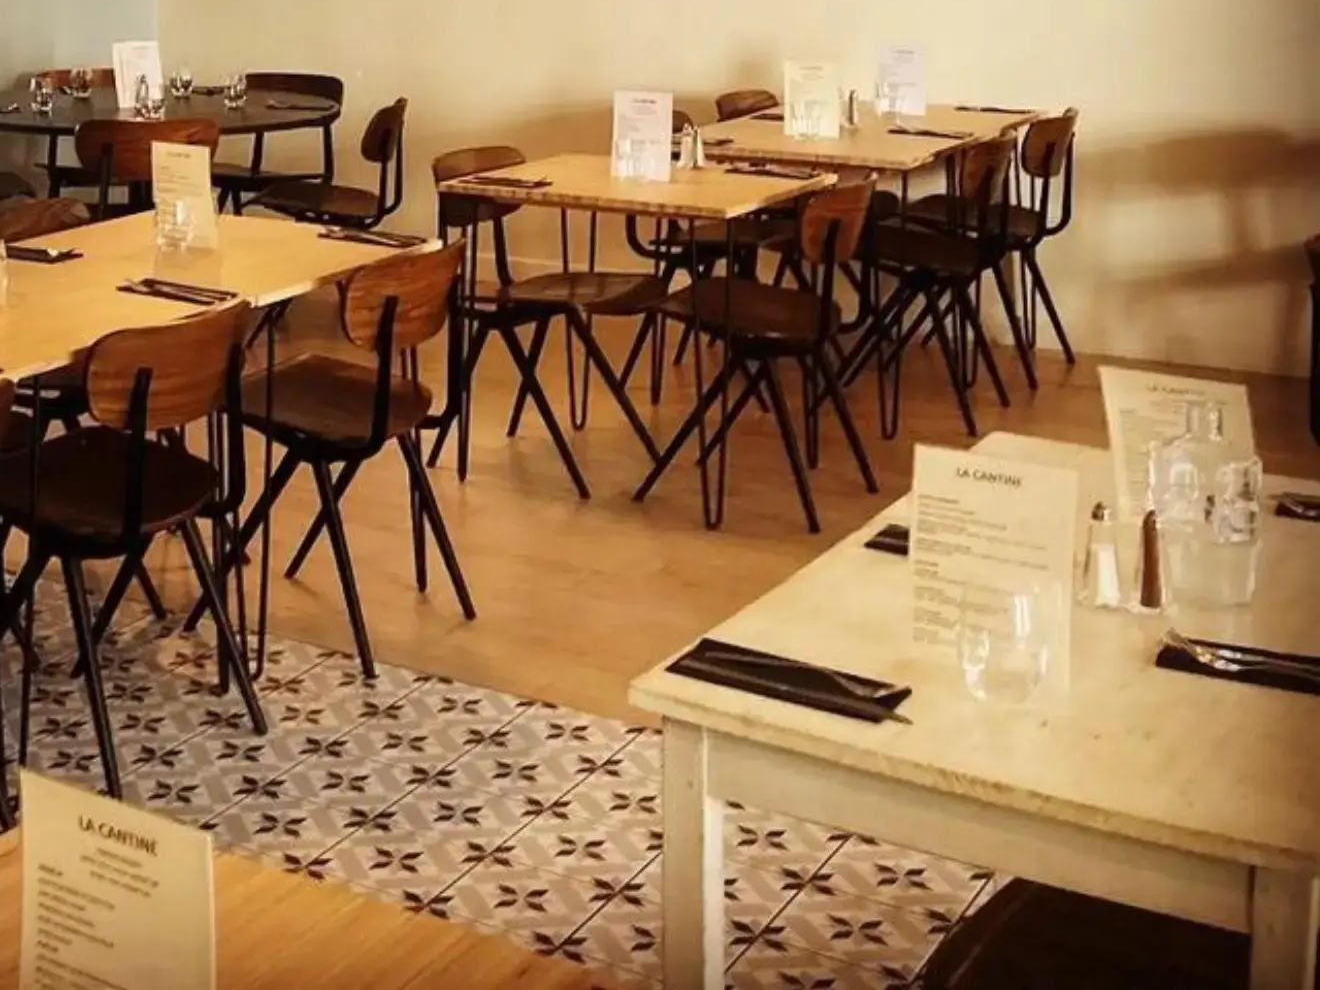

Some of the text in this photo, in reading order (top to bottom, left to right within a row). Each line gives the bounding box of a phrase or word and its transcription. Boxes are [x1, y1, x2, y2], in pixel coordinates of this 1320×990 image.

[956, 466, 1023, 489] LA CANTINE
[78, 814, 159, 858] LA CANTINE
